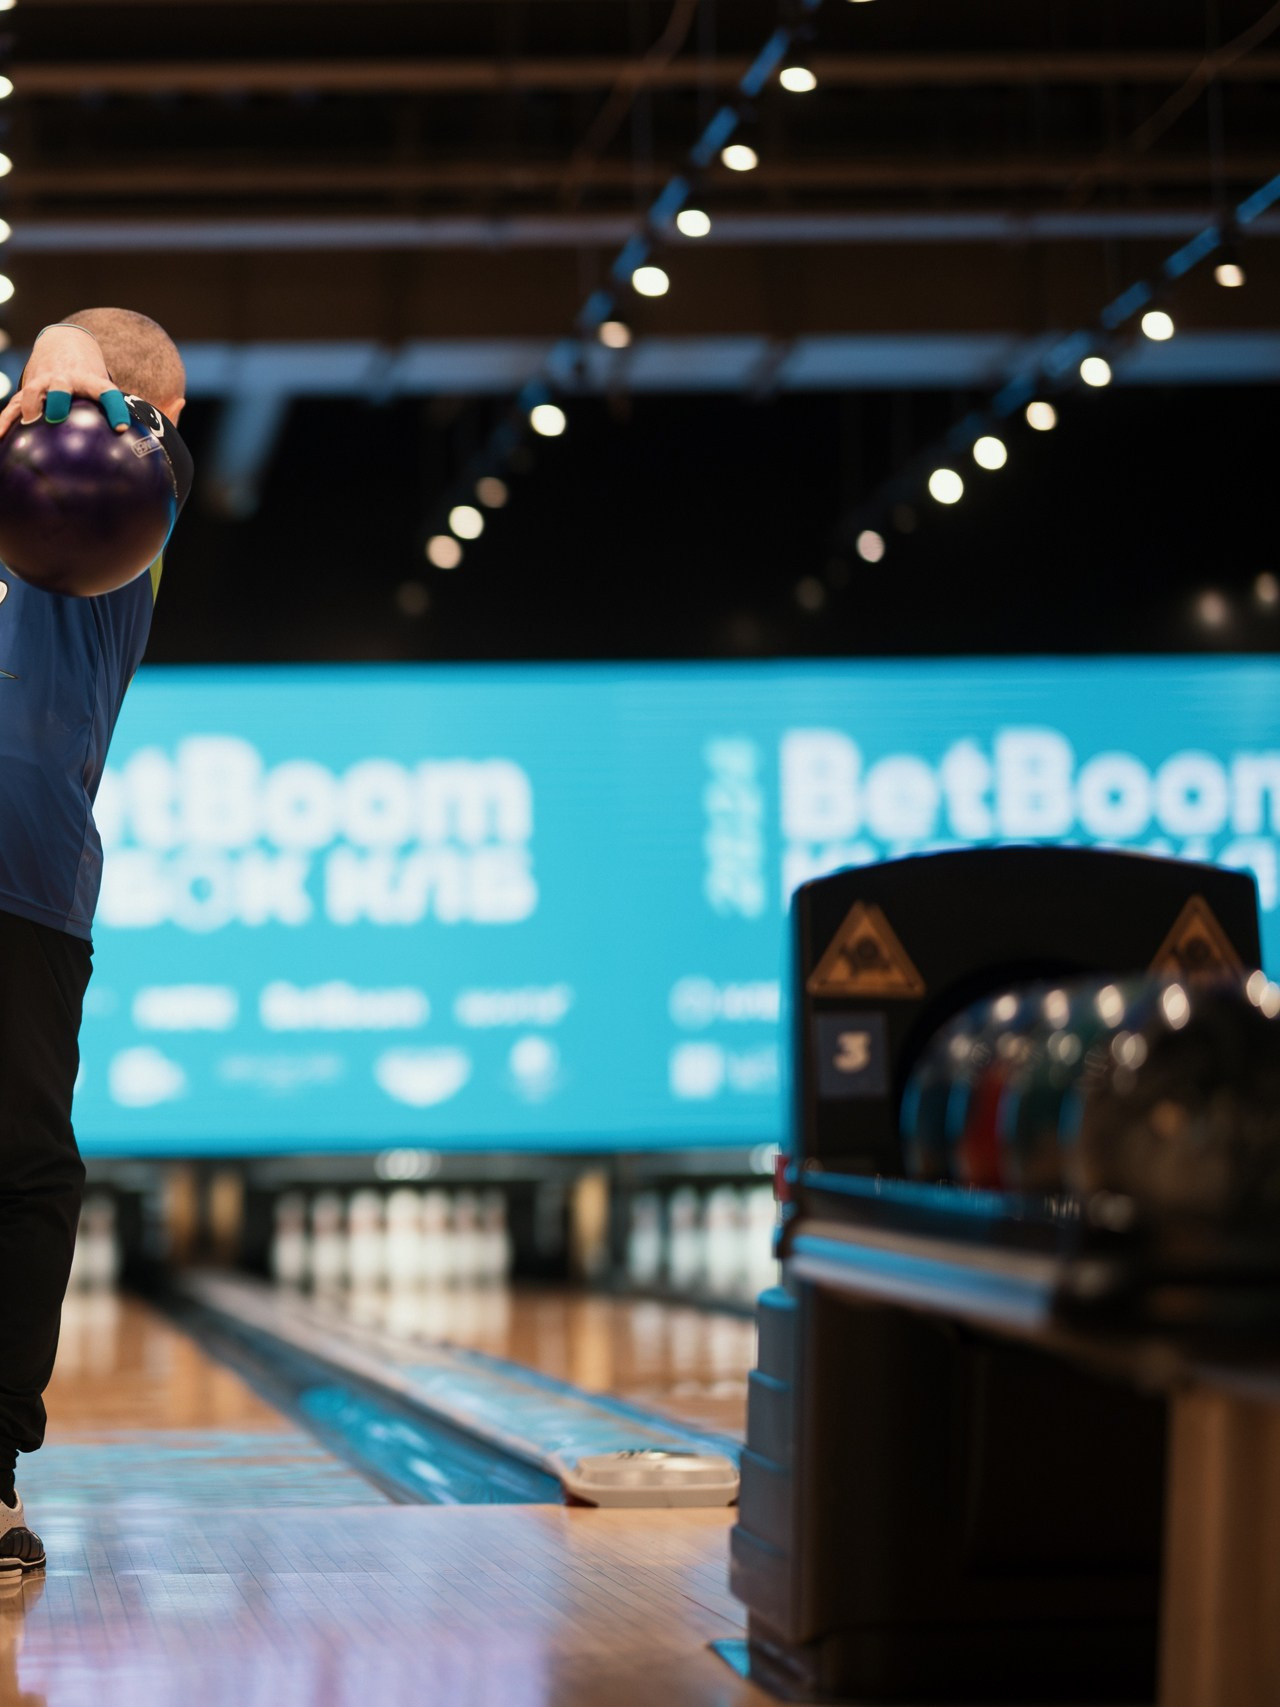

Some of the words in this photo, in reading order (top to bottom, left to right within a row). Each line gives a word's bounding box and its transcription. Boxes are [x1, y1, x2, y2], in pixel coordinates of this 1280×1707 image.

[94, 735, 533, 850] tBoom
[98, 848, 314, 931] БОК
[834, 1031, 870, 1073] 3
